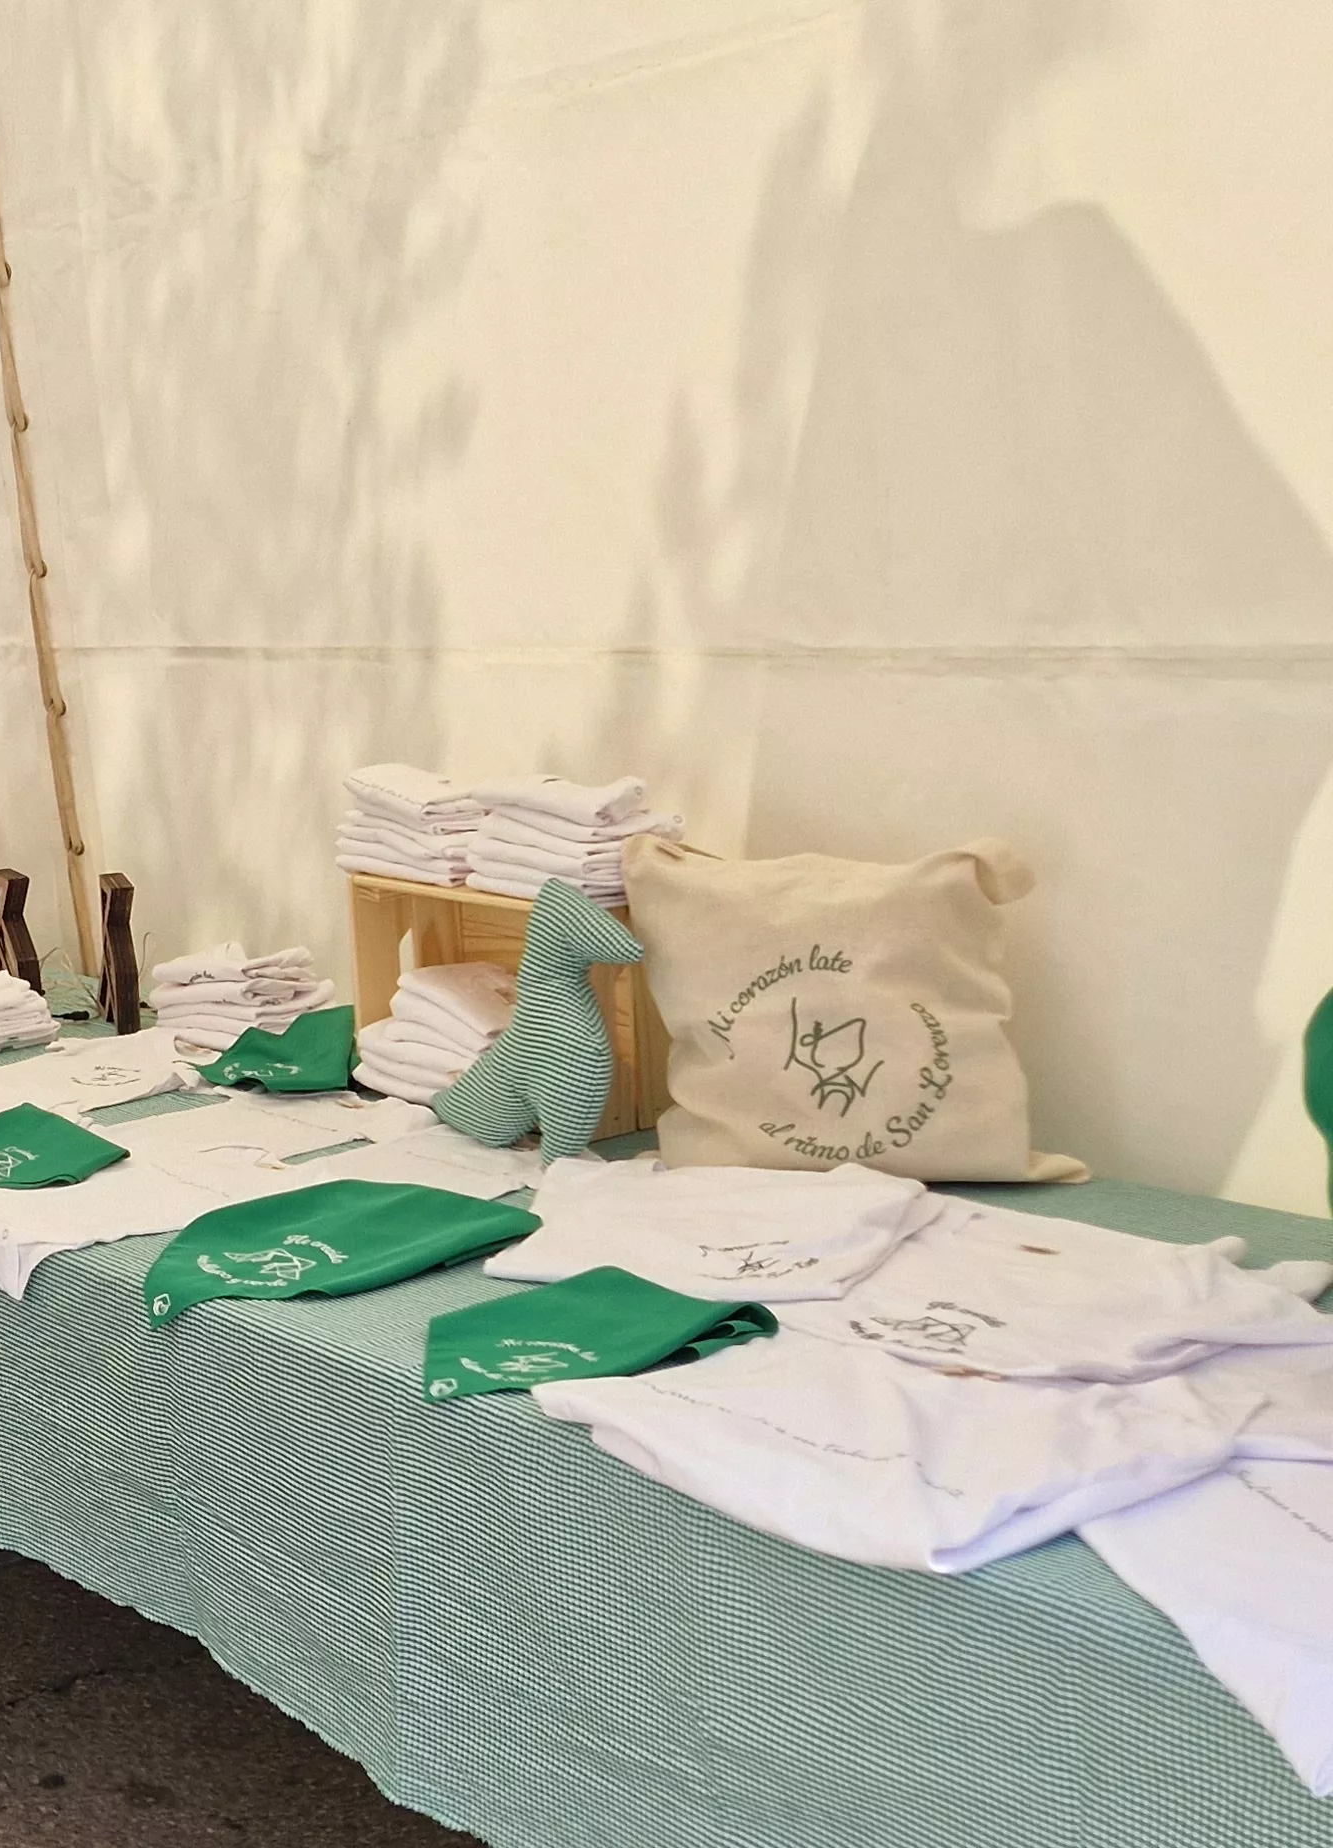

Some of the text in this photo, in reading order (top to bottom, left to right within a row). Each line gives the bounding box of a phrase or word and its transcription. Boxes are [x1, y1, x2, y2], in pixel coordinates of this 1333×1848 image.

[707, 944, 853, 1060] Mi corazón late
[759, 1002, 953, 1161] al ritmo de San Lorenzo
